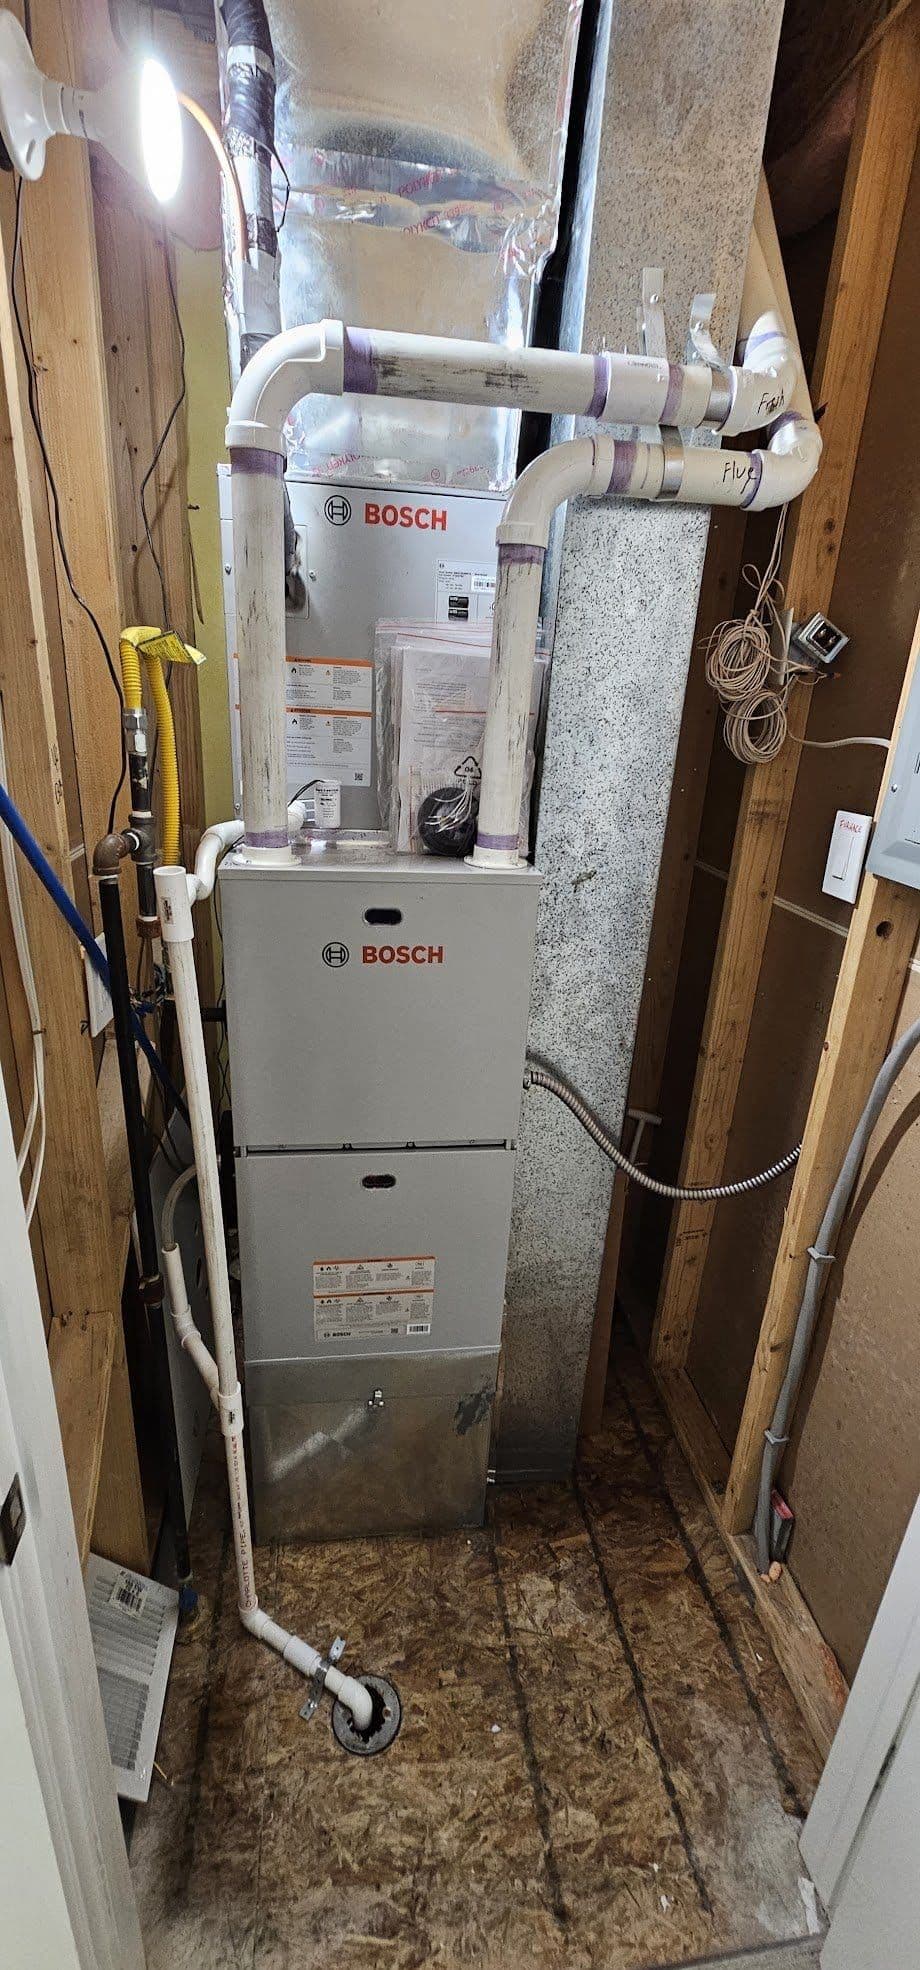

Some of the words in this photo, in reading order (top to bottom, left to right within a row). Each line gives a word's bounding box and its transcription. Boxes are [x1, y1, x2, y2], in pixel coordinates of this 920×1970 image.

[722, 460, 757, 494] Flue
[364, 502, 448, 531] BOSCH
[362, 945, 444, 964] BOSCH
